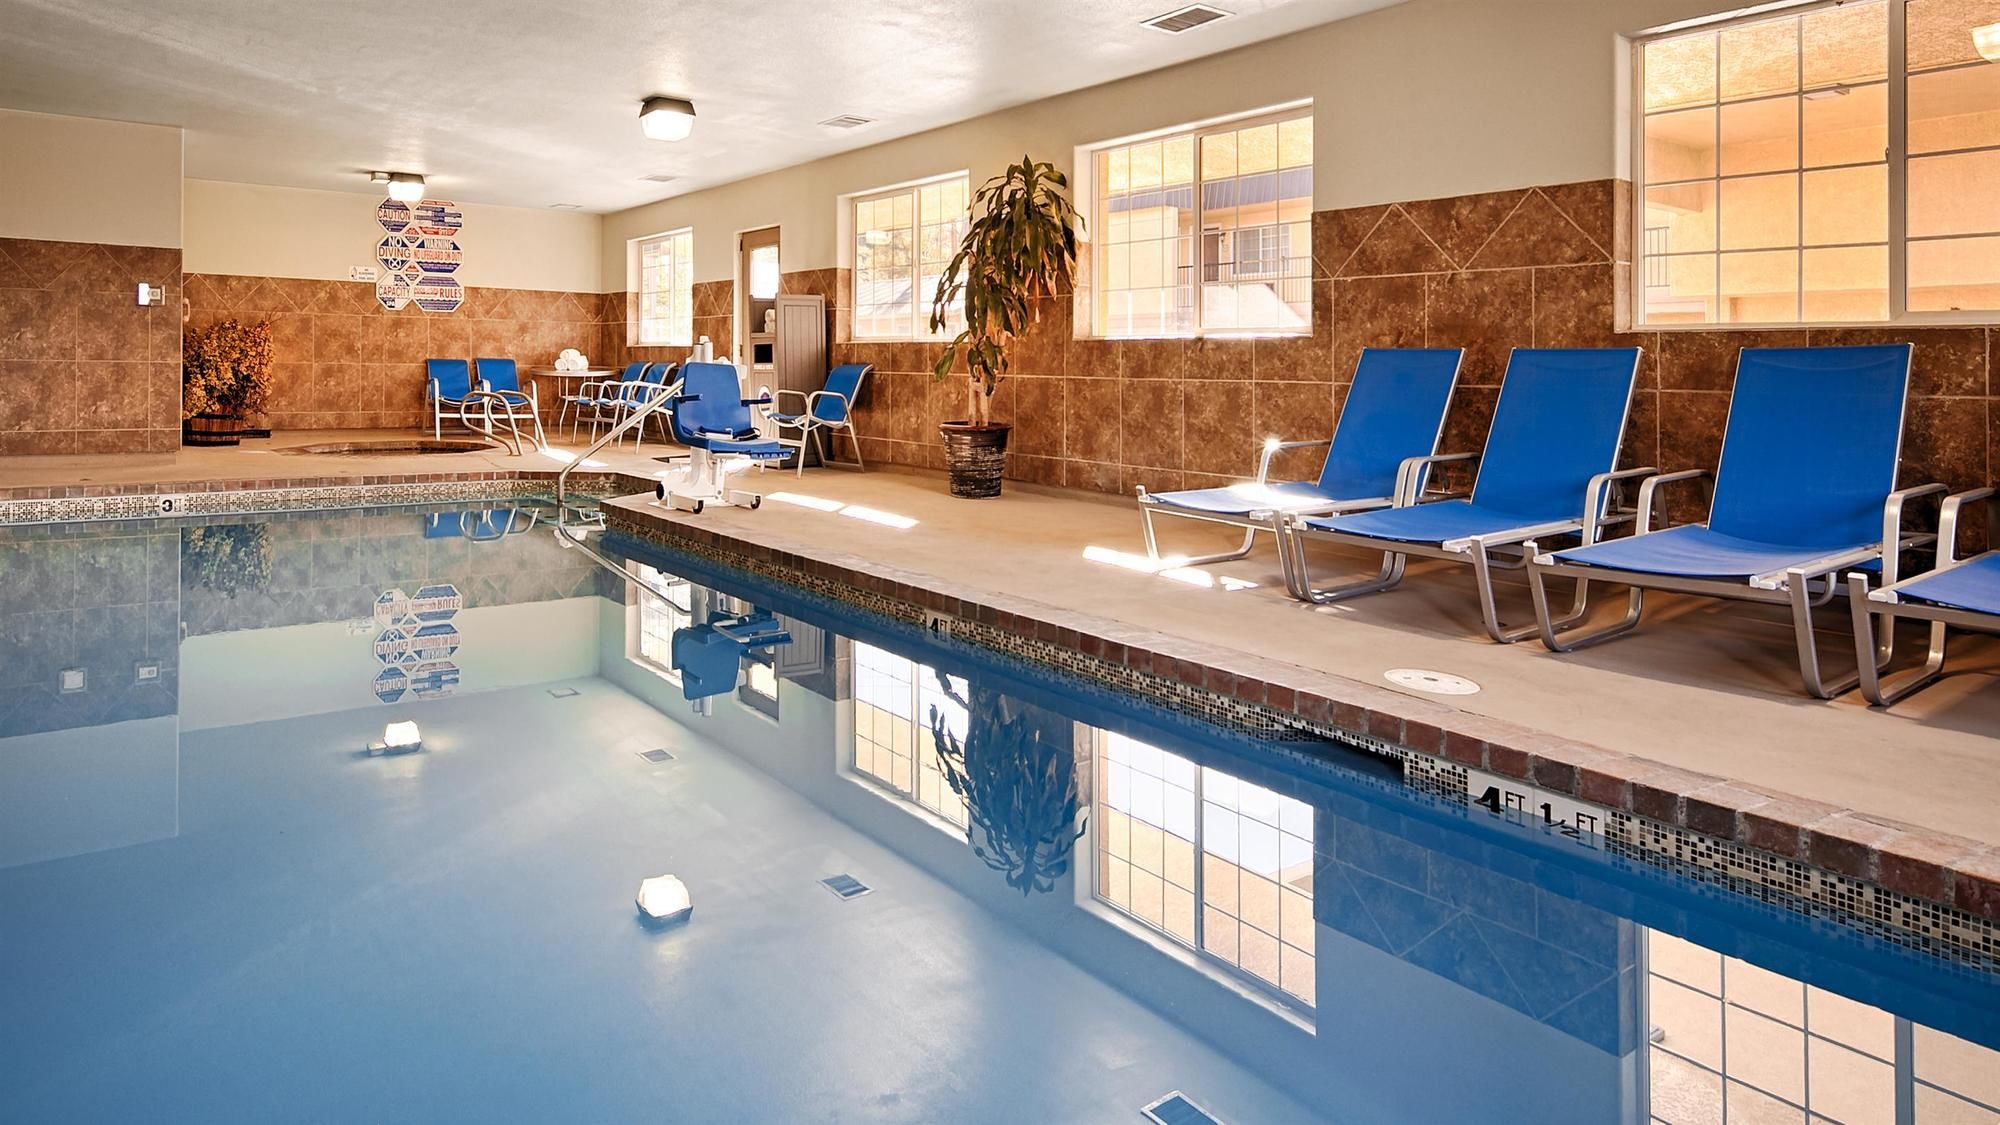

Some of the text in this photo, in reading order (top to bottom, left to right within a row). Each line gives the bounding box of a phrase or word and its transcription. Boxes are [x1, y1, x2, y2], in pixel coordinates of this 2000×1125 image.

[377, 209, 411, 221] CAUTION
[389, 236, 402, 247] NO
[424, 238, 454, 250] WARNING
[378, 247, 411, 258] DIVING
[378, 286, 411, 298] CAPACITY
[440, 288, 463, 298] RULES
[162, 499, 173, 512] 3
[1474, 786, 1504, 815] 4
[1505, 790, 1526, 812] FT
[1576, 811, 1598, 834] FT
